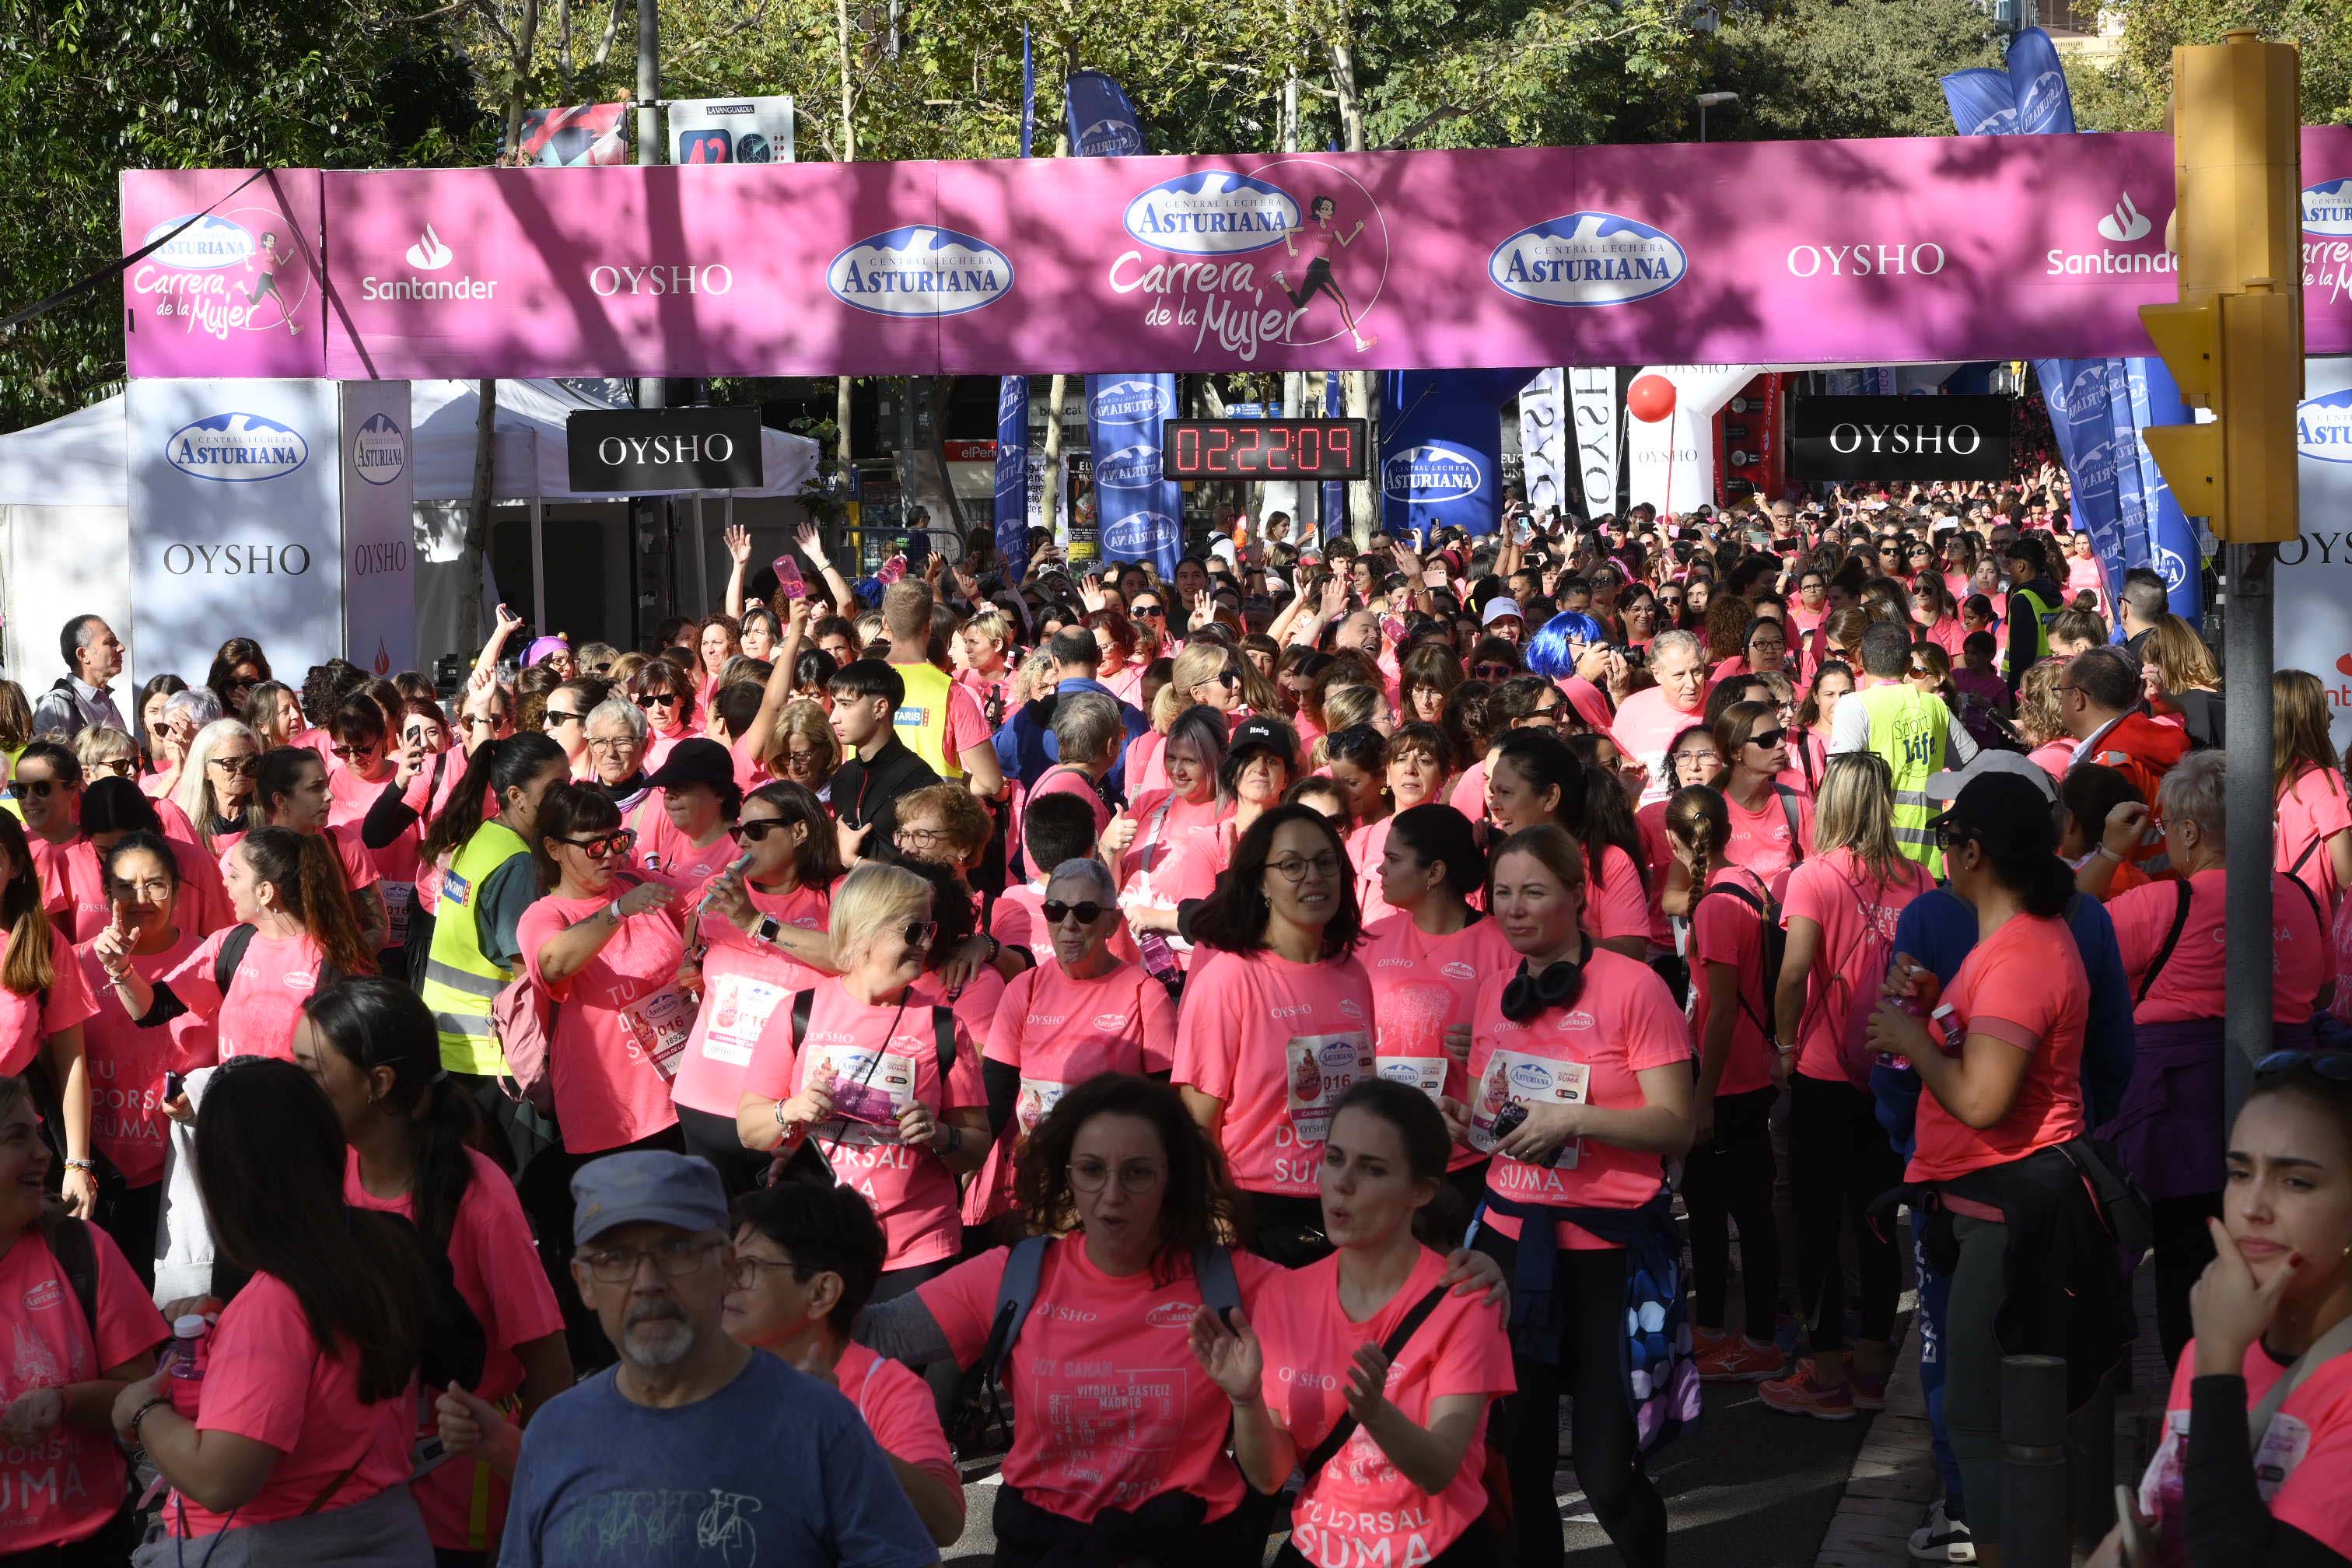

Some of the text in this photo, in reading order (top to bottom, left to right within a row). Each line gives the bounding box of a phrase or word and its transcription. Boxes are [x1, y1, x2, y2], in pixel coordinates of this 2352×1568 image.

[1164, 198, 1282, 208] CENTRAL LECHERA
[1138, 203, 1288, 234] ASTURIANA
[1535, 243, 1664, 254] CENTRAL LECHERA
[1787, 243, 1944, 278] OYSHO
[870, 256, 993, 267] CENTRAL LECHERA
[1109, 250, 1255, 294] Carrera
[1504, 249, 1671, 282] ASTURIANA
[134, 265, 225, 294] Carrera
[589, 264, 733, 297] OYSHO
[841, 260, 999, 293] ASTURIANA
[2319, 264, 2333, 285] la
[362, 275, 498, 301] Santander
[156, 292, 261, 341] de la Mujer
[1145, 290, 1310, 362] de la Mujer
[177, 439, 299, 464] ASTURIANA
[599, 432, 733, 466] OYSHO
[1177, 428, 1351, 471] 02:22:09
[1829, 423, 1981, 455] OYSHO
[357, 443, 403, 467] ASTURIANA
[1639, 450, 1699, 463] OYSHO
[1386, 468, 1474, 490] ASTURIANA
[163, 544, 310, 576] OYSHO
[355, 541, 407, 576] OYSHO
[1894, 715, 1931, 740] Sport
[1903, 731, 1936, 765] Life
[1377, 957, 1413, 969] OYSHO
[607, 980, 635, 1006] TU
[1027, 1014, 1065, 1025] OYSHO
[1270, 1003, 1312, 1019] OYSHO
[658, 1015, 684, 1037] 016
[666, 1031, 686, 1046] 18925
[1324, 1074, 1352, 1090] 016
[1513, 1071, 1550, 1087] ASTURIANA
[1557, 1075, 1580, 1084] SUMA
[93, 1114, 160, 1139] SUMA
[821, 1142, 909, 1170] ORSAL
[1500, 1164, 1565, 1192] SUMA
[1077, 1385, 1118, 1398] VITORIA
[1129, 1384, 1171, 1397] GASTEIZ
[1279, 1367, 1337, 1391] OYSHO
[1099, 1398, 1142, 1409] MADRID
[1296, 1523, 1432, 1568] SUMA
